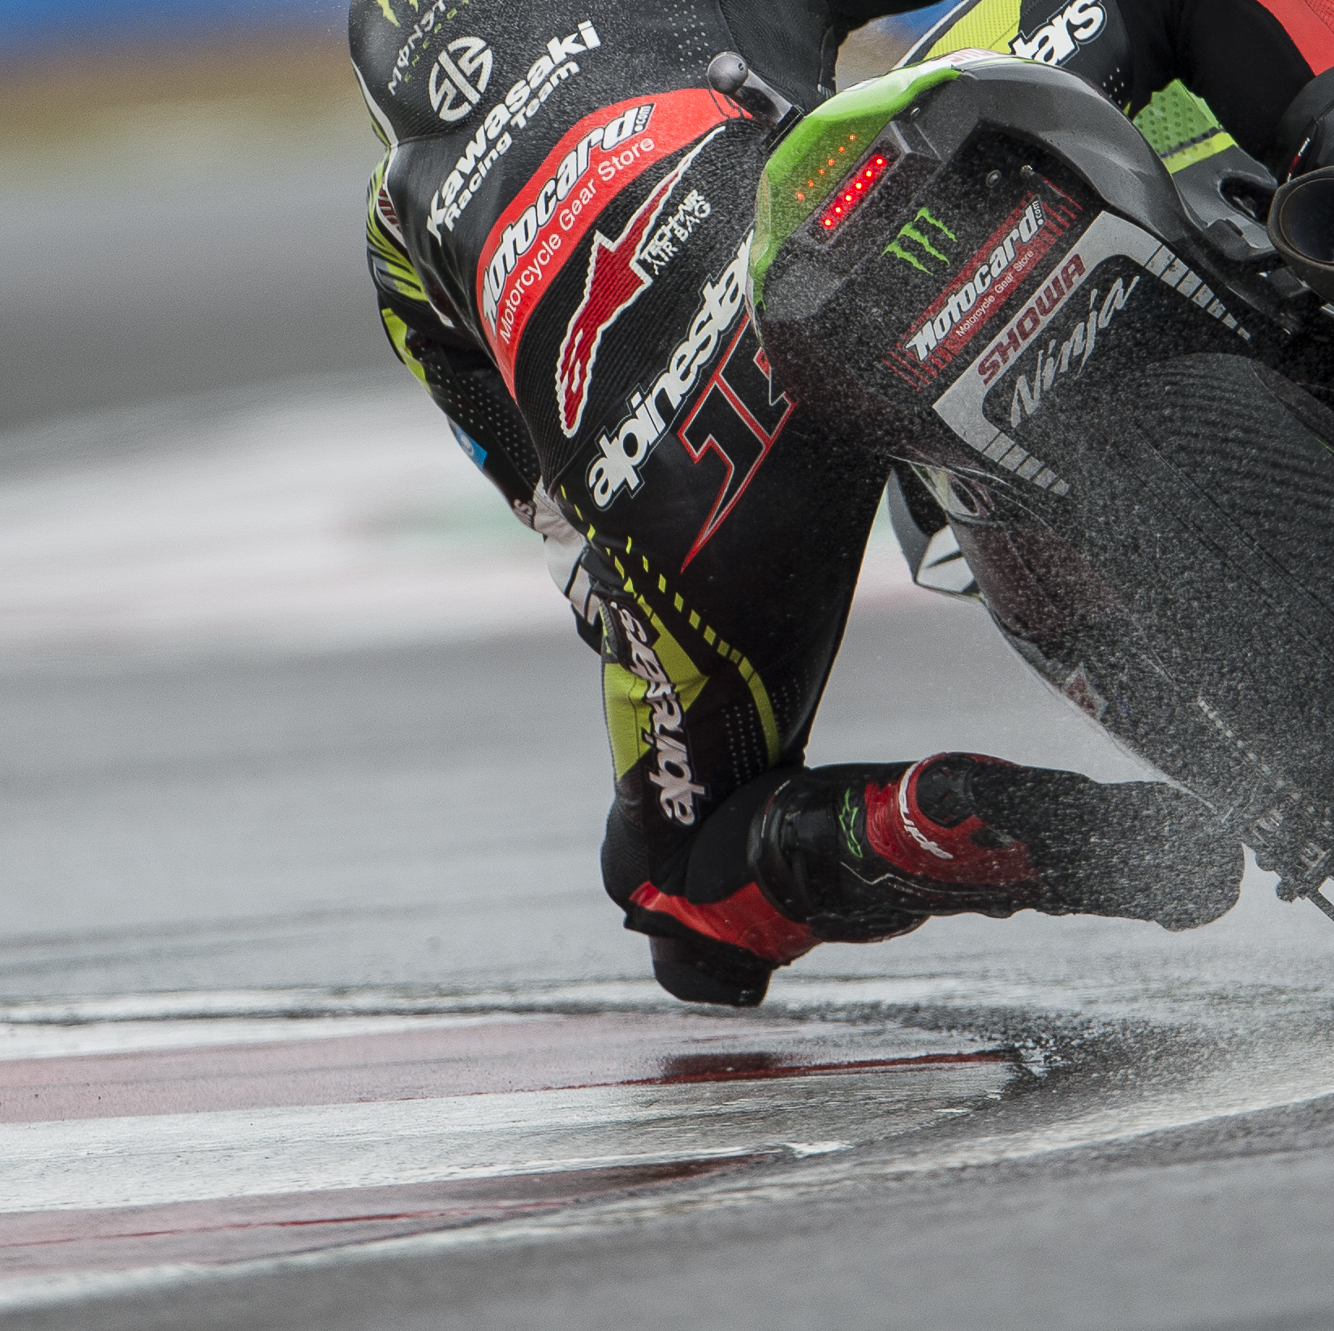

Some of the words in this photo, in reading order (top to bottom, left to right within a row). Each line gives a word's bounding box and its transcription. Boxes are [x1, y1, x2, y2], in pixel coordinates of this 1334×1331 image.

[427, 19, 601, 246] Kawasaki
[444, 131, 513, 232] Racing
[510, 61, 581, 129] Team
[499, 229, 562, 345] Motorcycle
[559, 179, 596, 232] Gear
[597, 138, 655, 182] Store
[653, 242, 679, 276] AIR
[674, 200, 711, 243] BAG
[956, 295, 996, 337] Motorcycle
[1013, 250, 1035, 273] Store
[977, 253, 1086, 386] SHOWA
[1011, 275, 1141, 427] Ninja
